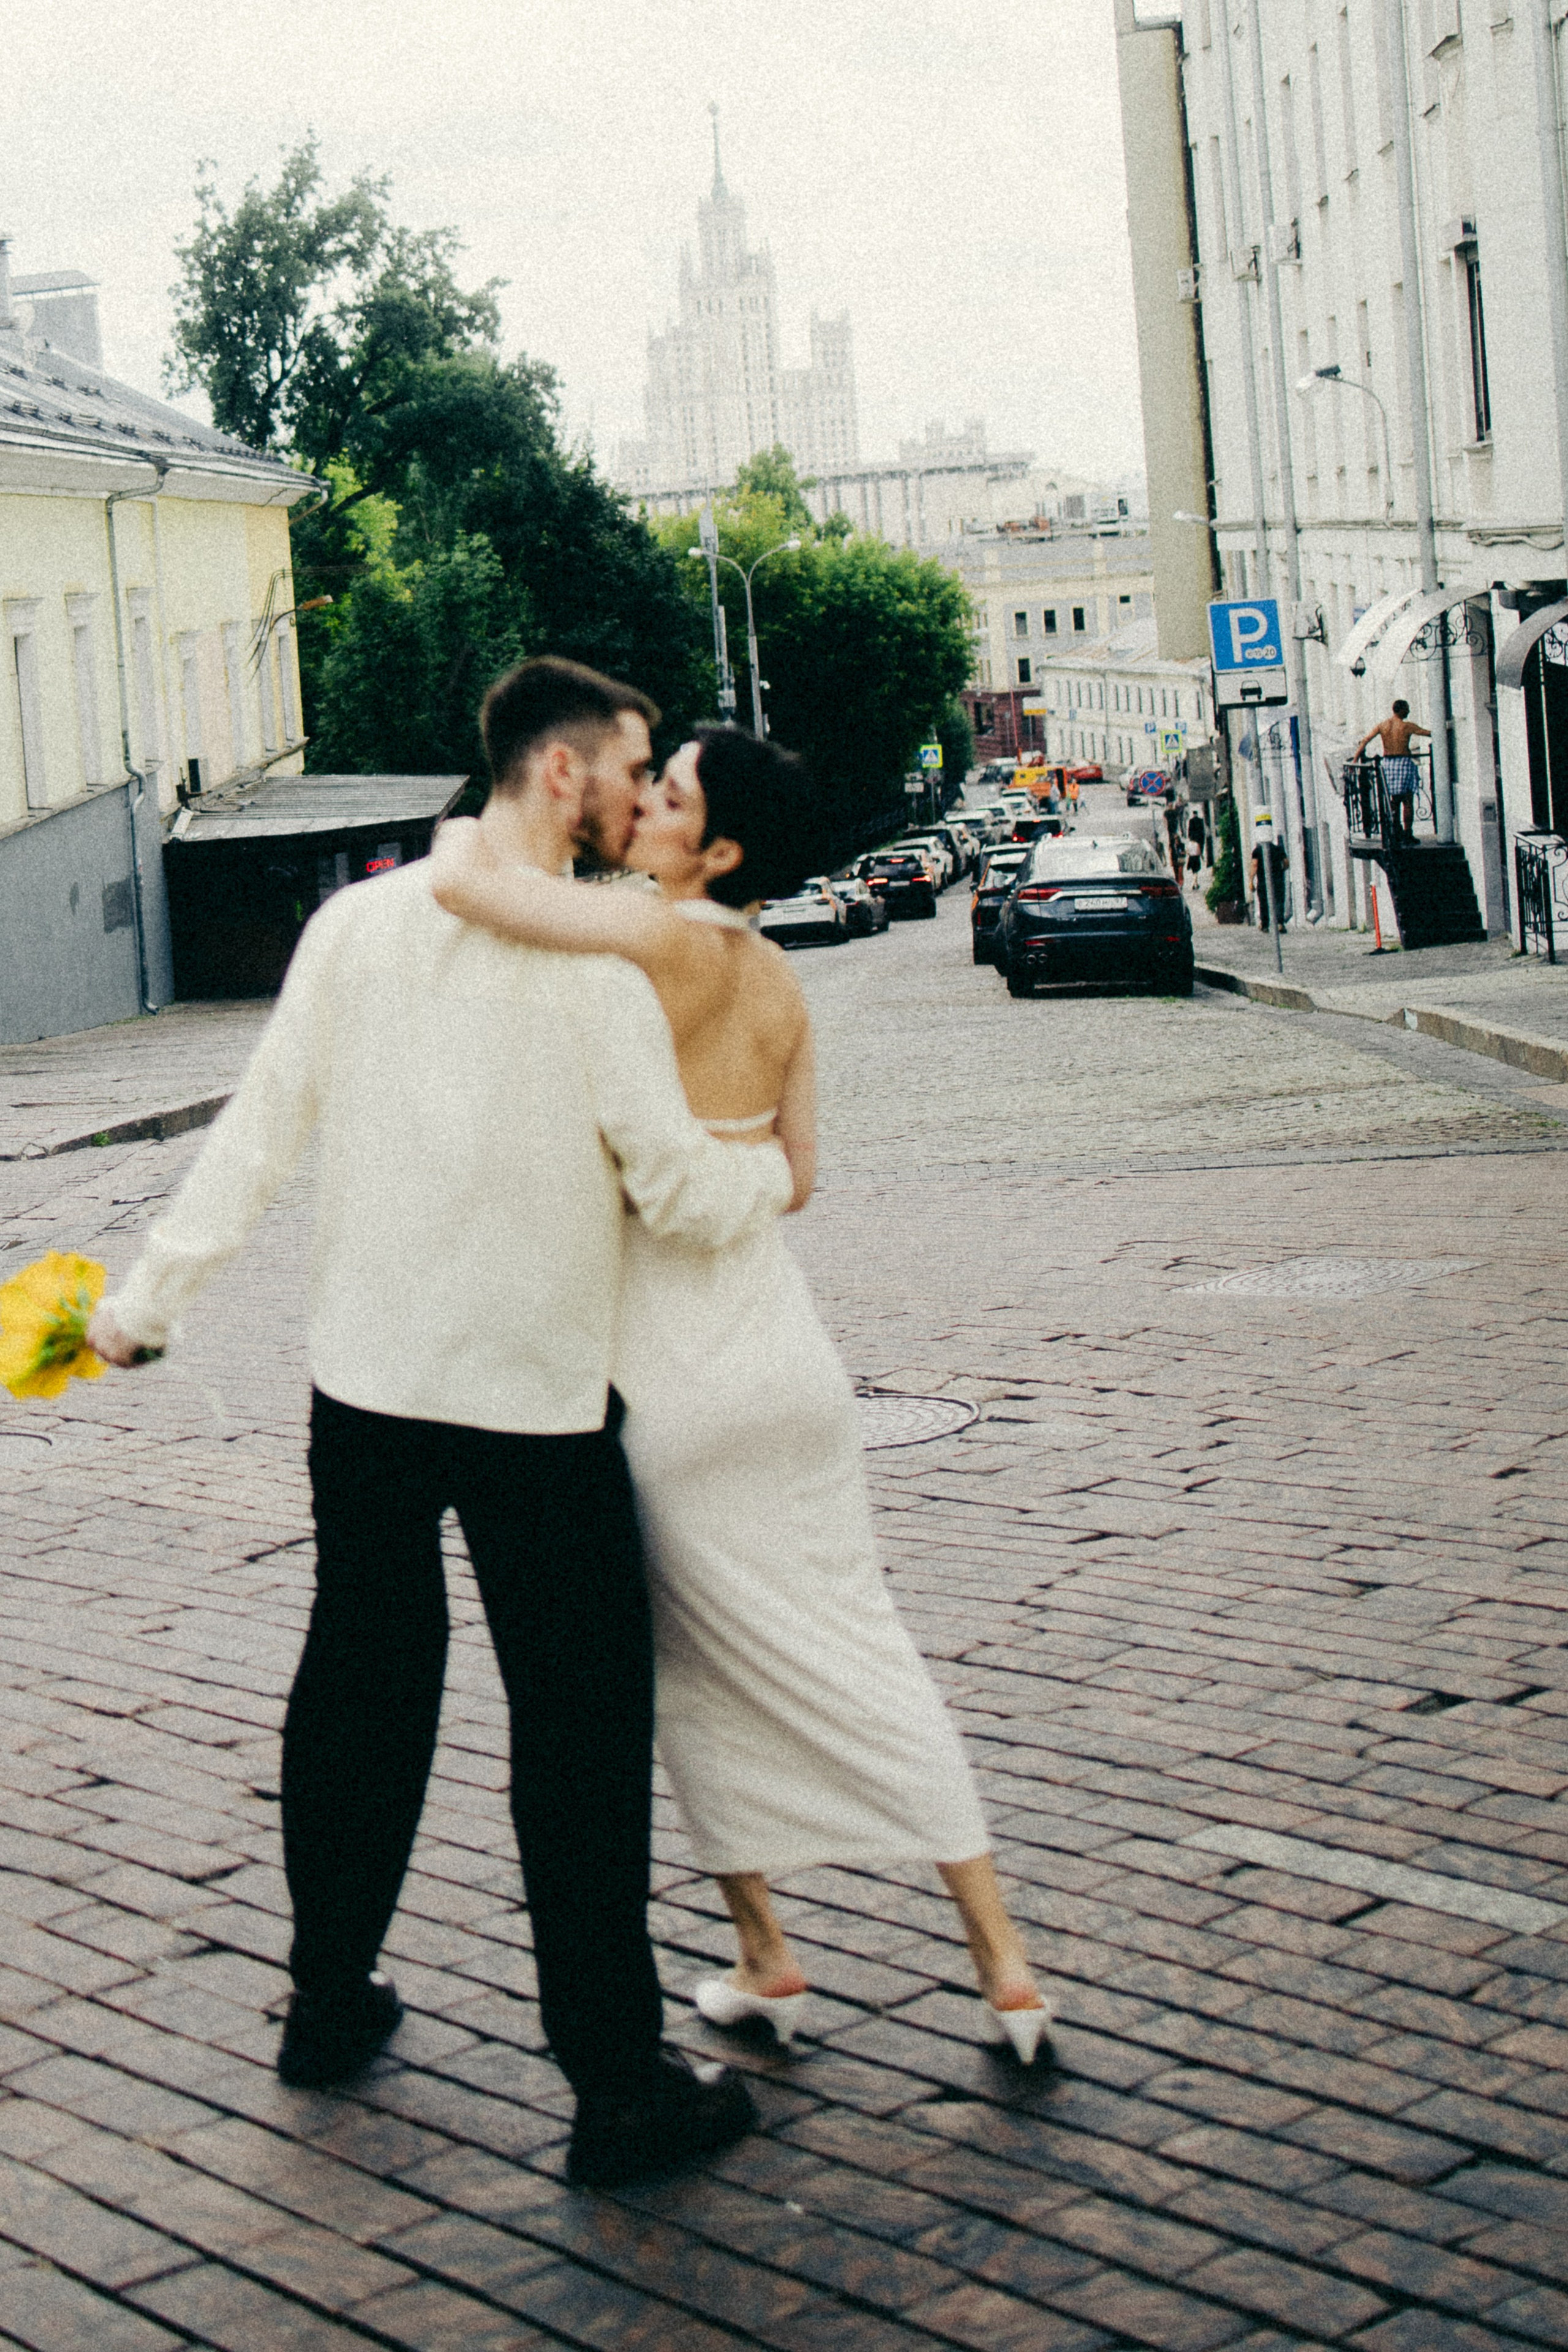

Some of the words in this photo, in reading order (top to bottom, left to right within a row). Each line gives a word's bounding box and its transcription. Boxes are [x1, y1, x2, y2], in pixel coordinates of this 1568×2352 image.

[1229, 607, 1268, 663] P
[1264, 647, 1275, 656] 20
[366, 858, 394, 872] OPEN
